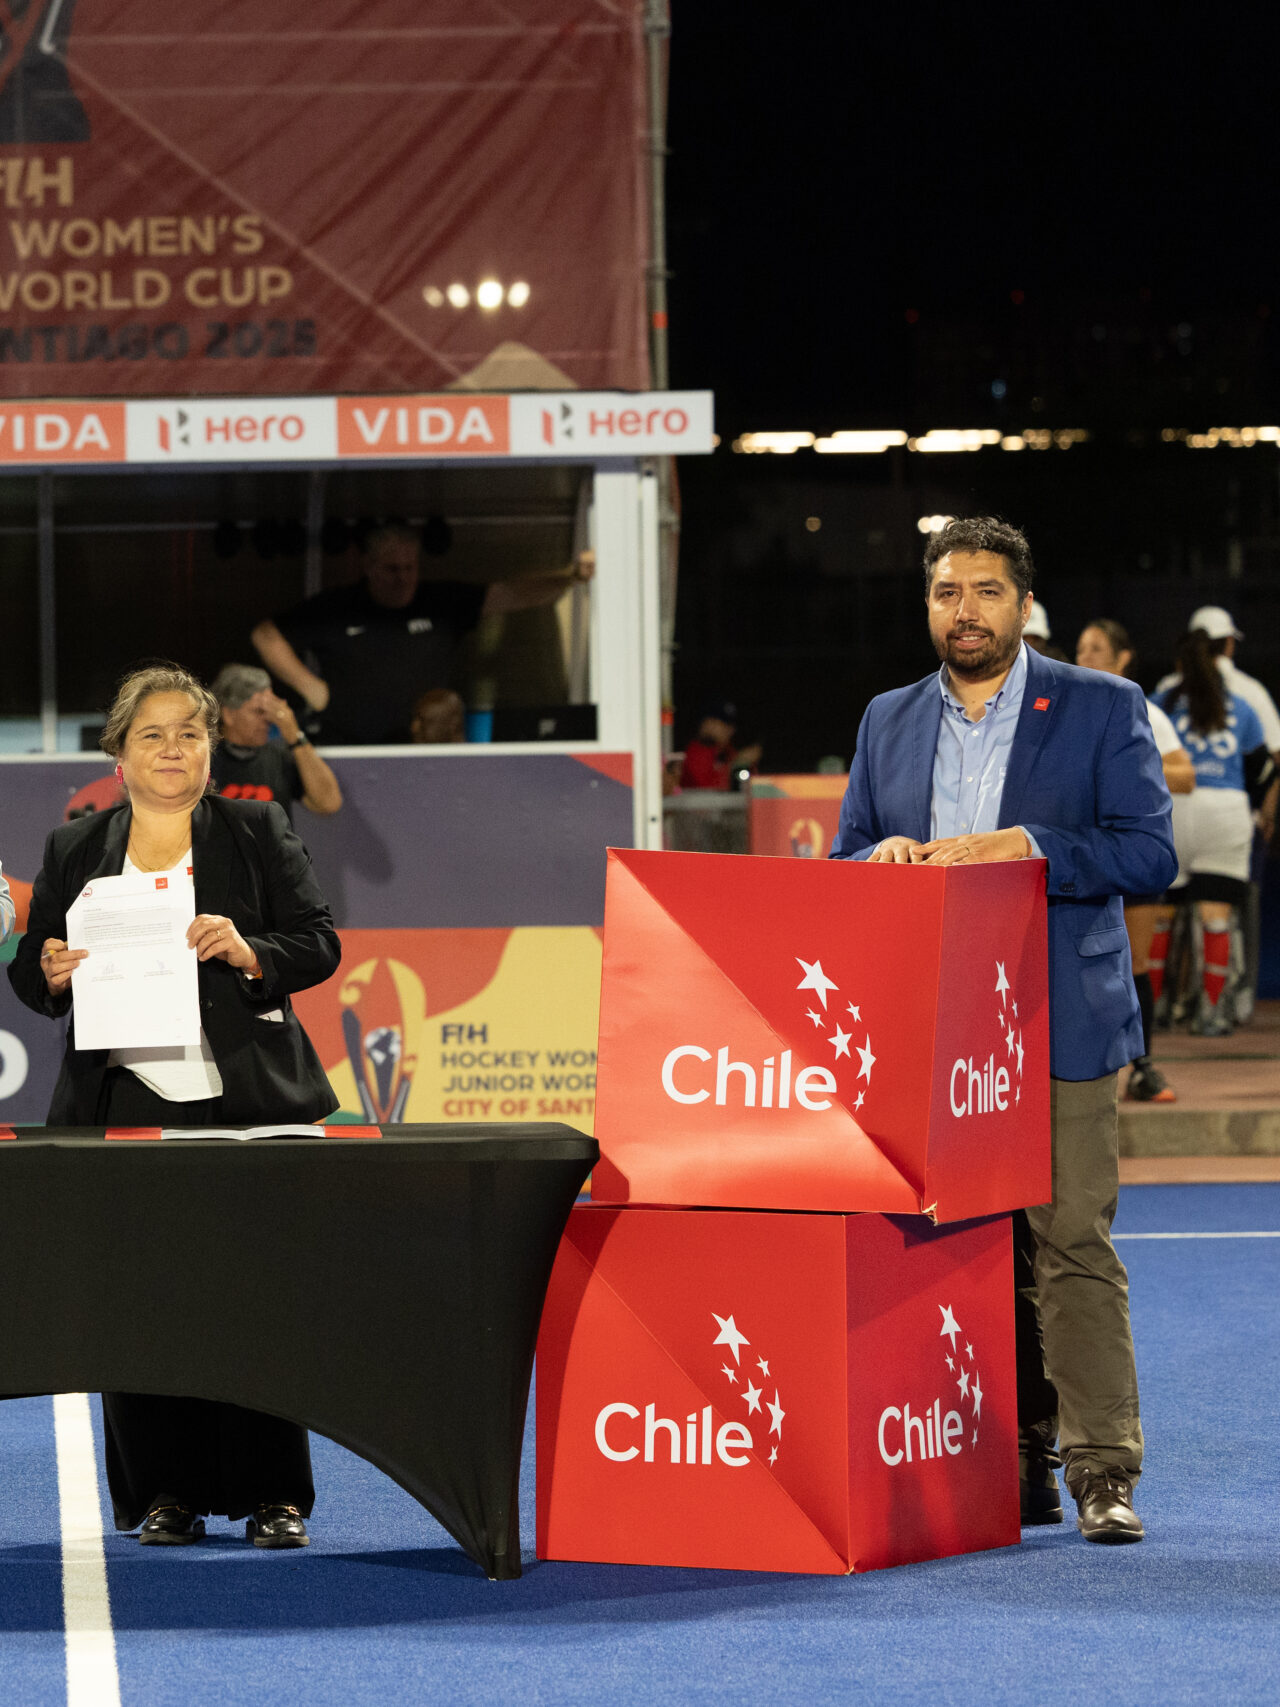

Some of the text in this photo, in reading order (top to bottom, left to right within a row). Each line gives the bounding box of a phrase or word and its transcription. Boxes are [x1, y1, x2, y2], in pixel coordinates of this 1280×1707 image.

[10, 213, 265, 260] WOMEN'S
[184, 265, 294, 309] CUP
[204, 318, 318, 359] 2025
[205, 414, 305, 443] Hero
[353, 406, 494, 445] VIDA
[589, 407, 689, 436] Hero
[441, 1023, 488, 1045] FIH
[441, 1051, 540, 1069] HOCKEY
[661, 1044, 837, 1112] Chile
[443, 1074, 535, 1093] JUNIOR
[949, 1053, 1010, 1118] Chile
[443, 1098, 492, 1117] CITY
[500, 1098, 529, 1117] OF
[594, 1402, 753, 1467] Chile
[878, 1398, 963, 1466] Chile
